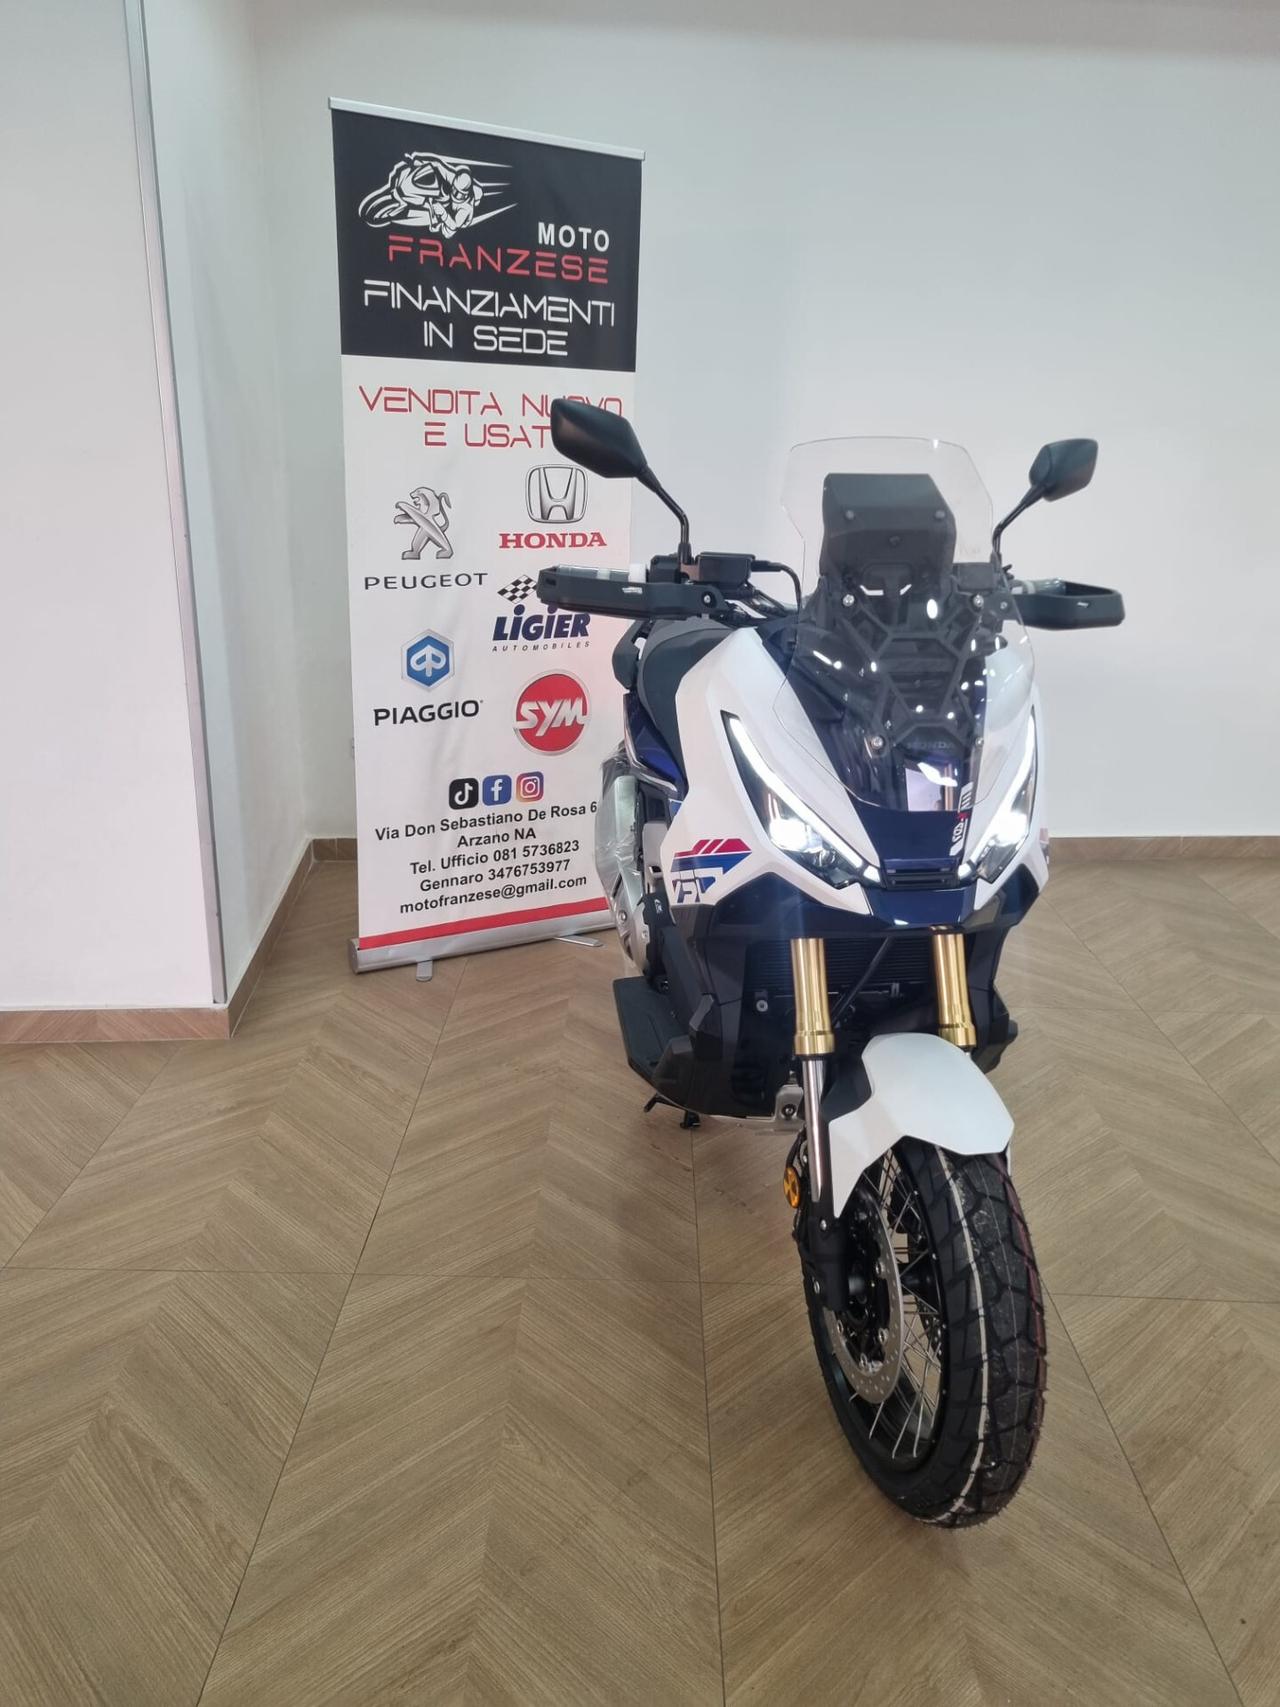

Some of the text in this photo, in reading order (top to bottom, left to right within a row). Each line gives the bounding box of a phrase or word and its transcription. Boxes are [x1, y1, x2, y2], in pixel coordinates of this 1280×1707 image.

[537, 221, 610, 252] MOTO
[387, 234, 609, 284] FRANZESE
[363, 278, 616, 327] FINANZIAMENTI
[423, 320, 569, 356] IN SEDE
[358, 385, 503, 416] VENDITA
[424, 421, 447, 447] E
[499, 532, 607, 549] HONDA
[364, 572, 488, 590] PEUGEOT
[492, 641, 590, 653] AUTOMOBILES
[373, 699, 480, 727] PIAGGIO
[513, 697, 590, 737] SYM
[375, 825, 400, 841] Via
[405, 823, 436, 837] Don
[440, 811, 523, 832] Sebastiano
[528, 808, 547, 821] De
[551, 804, 587, 818] Rosa
[457, 828, 537, 848] Arzano NA
[410, 840, 580, 875] Tel. Ufficio 081 5736823
[420, 859, 571, 892] Gennaro 3476753977
[400, 876, 587, 913] motofranzese@gmail.com
